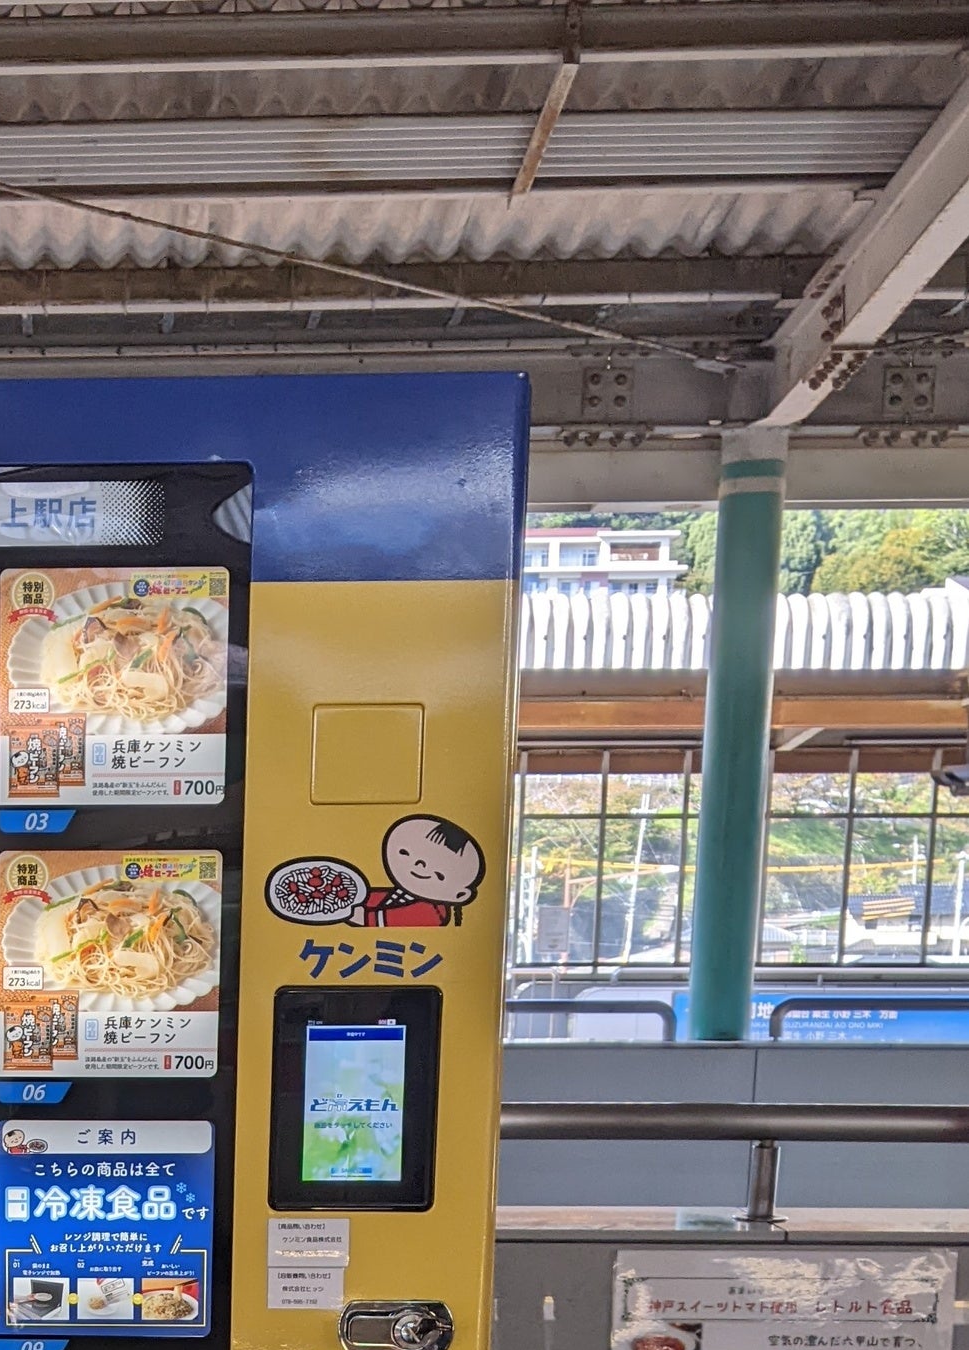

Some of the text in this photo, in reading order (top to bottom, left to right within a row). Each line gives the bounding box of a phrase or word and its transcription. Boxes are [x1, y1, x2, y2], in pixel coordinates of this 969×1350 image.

[22, 582, 44, 593] 特別
[22, 593, 44, 604] 商品
[14, 700, 47, 710] 273kcal
[112, 740, 202, 754] 兵庫ケンミン
[111, 755, 186, 770] 焼ビーフン
[184, 780, 225, 796] 700円
[25, 813, 49, 830] 03
[17, 864, 38, 874] 特別
[17, 875, 38, 886] 商品
[299, 939, 443, 979] ケンミン
[8, 977, 41, 987] 273kcal
[104, 1016, 192, 1030] 兵庫ケンミン
[103, 1031, 176, 1045] 焼ビーフン
[174, 1055, 214, 1070] 700円
[22, 1084, 46, 1101] 06
[77, 1129, 137, 1145] ご案内
[34, 1162, 176, 1177] こちらの商品は全て
[33, 1184, 209, 1222] 冷凍食品 です
[64, 1232, 148, 1242] レンジ調理で簡単に
[50, 1244, 162, 1253] お召し上がりいただけます
[816, 1300, 913, 1315] レトルト食品
